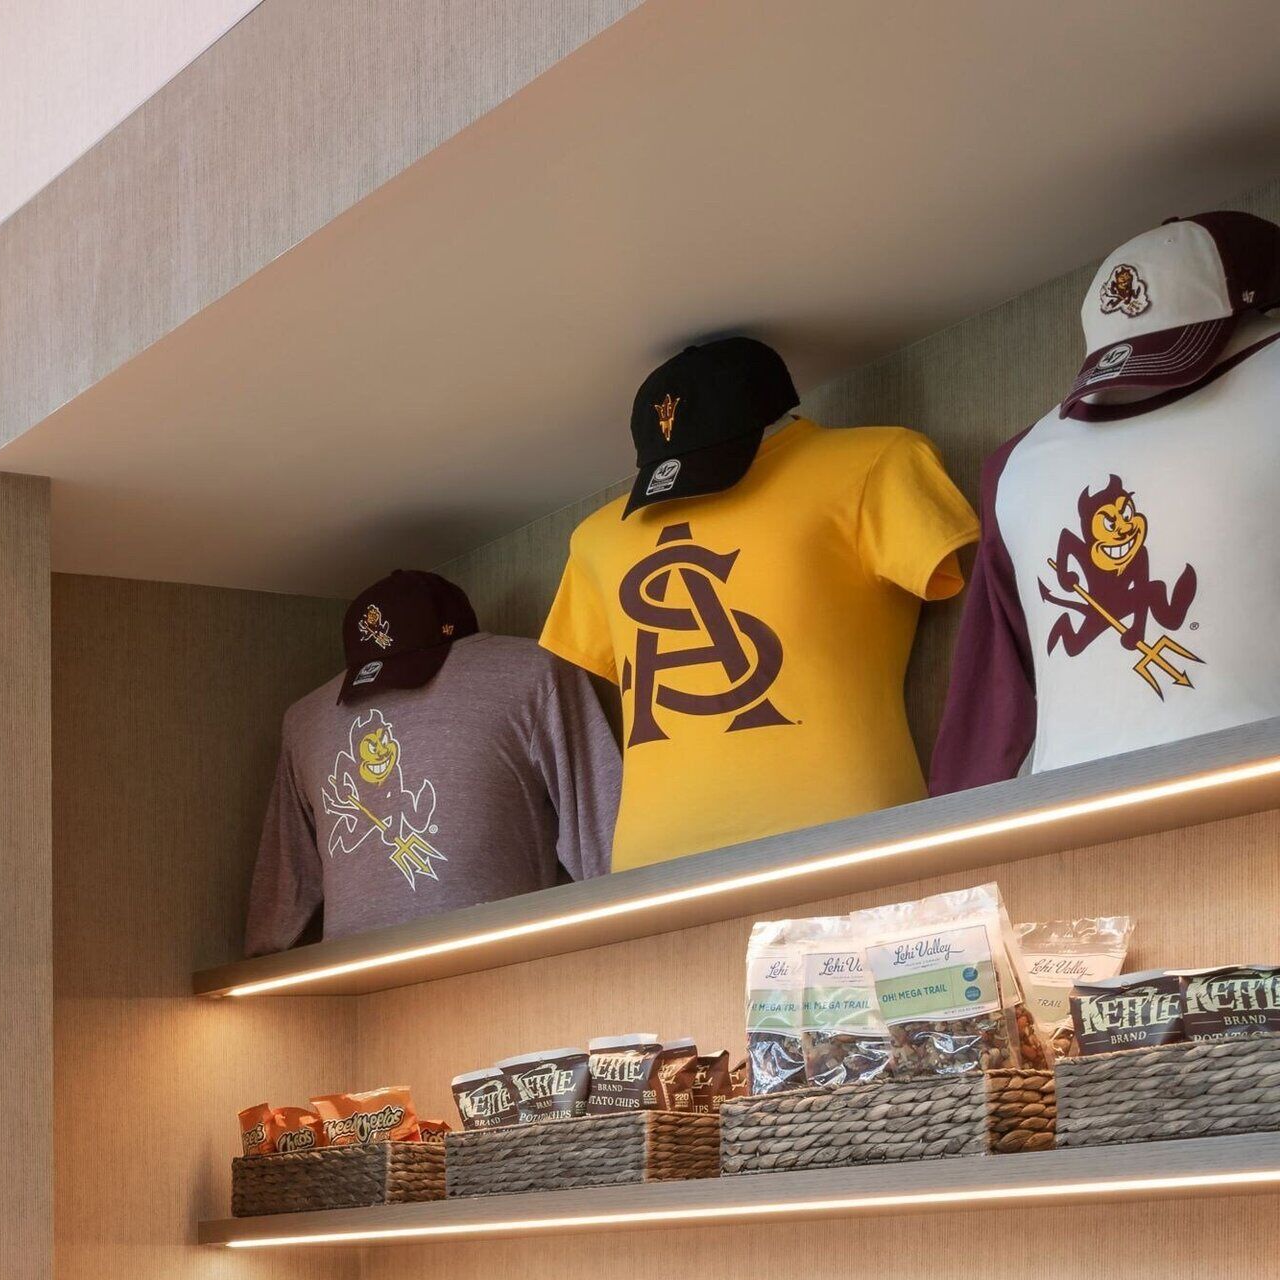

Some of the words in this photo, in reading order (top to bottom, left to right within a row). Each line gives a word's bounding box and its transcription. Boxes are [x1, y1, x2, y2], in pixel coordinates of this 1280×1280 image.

[893, 944, 915, 966] Lehi
[915, 937, 965, 961] Valley
[819, 957, 845, 976] Lehi
[898, 987, 922, 1000] MEGA
[924, 984, 948, 996] TRAIL
[1223, 1014, 1267, 1026] BRAND
[1110, 1030, 1147, 1045] BRAND
[597, 1083, 623, 1093] BRAND
[614, 1097, 640, 1108] CHIPS
